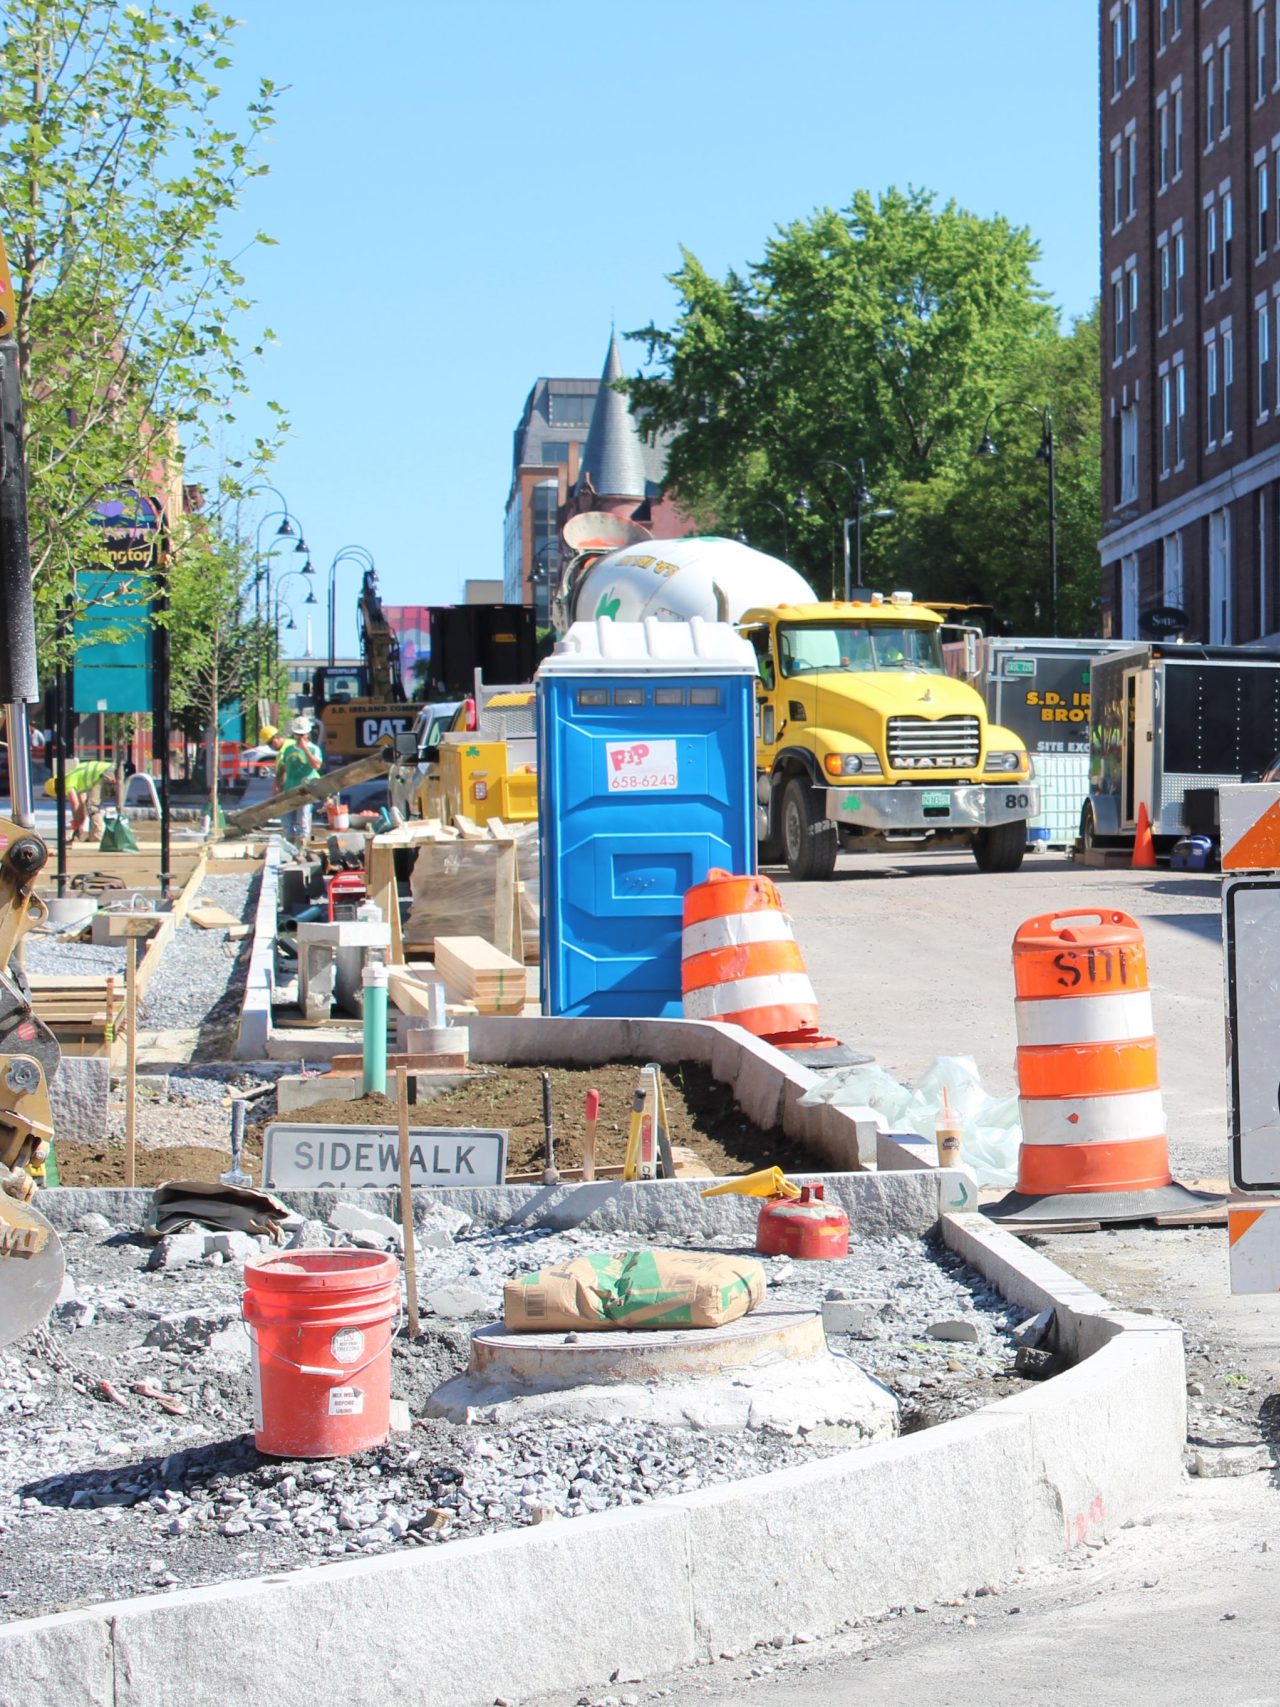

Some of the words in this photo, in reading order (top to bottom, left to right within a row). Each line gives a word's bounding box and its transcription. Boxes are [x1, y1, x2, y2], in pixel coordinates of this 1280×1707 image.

[1025, 691, 1066, 706] S.D.
[363, 719, 406, 746] CAT
[1037, 741, 1064, 752] SITE
[893, 756, 976, 768] MACK
[612, 774, 676, 789] 658-6243
[1005, 794, 1029, 809] 80
[294, 1141, 476, 1174] SIDEWALK
